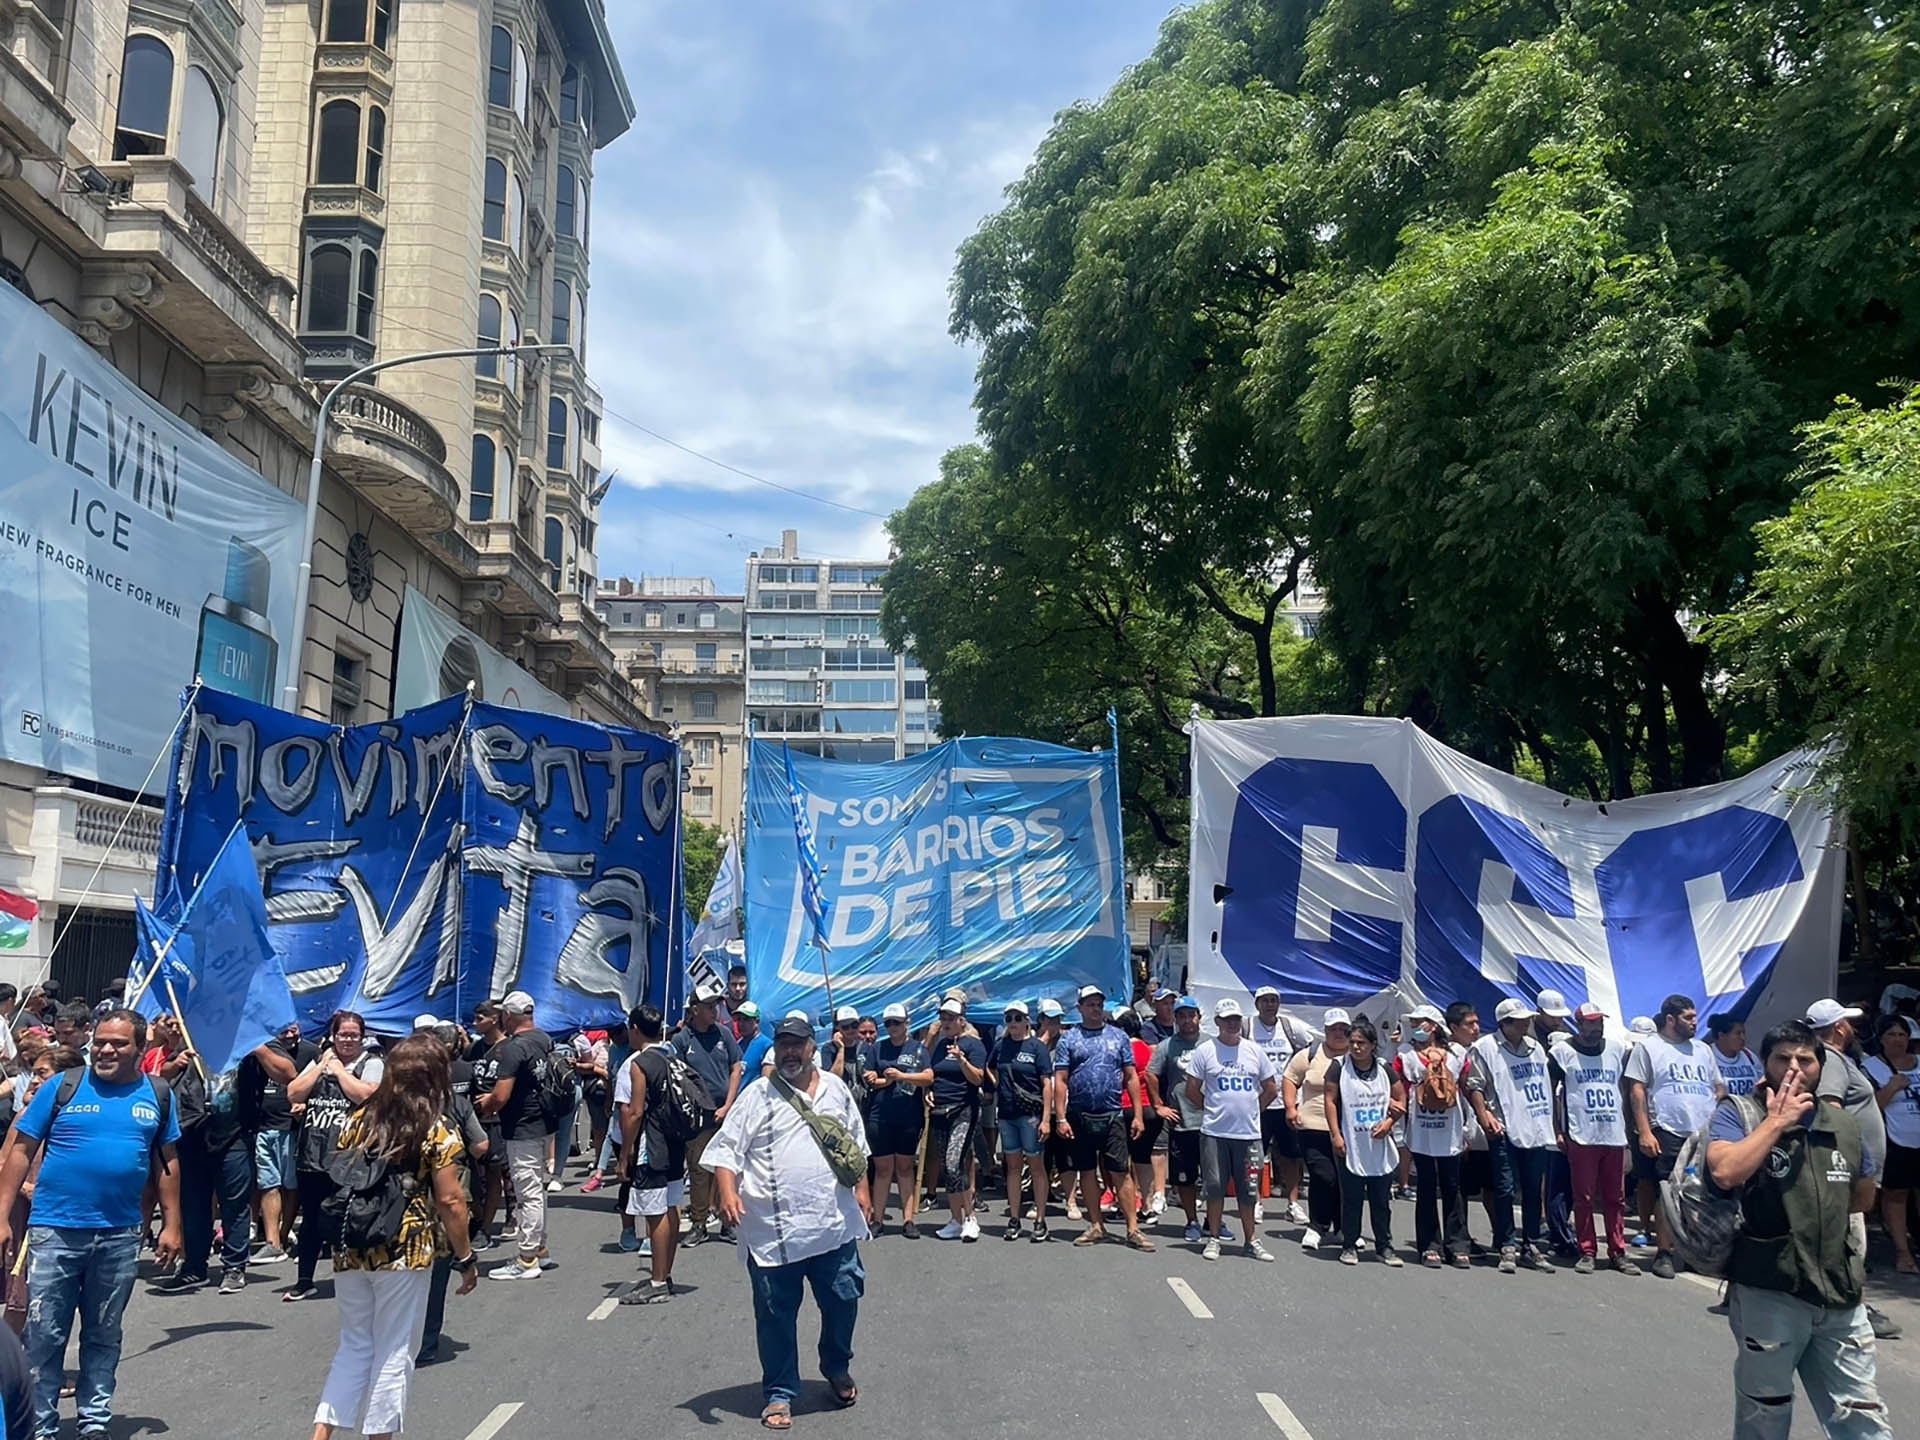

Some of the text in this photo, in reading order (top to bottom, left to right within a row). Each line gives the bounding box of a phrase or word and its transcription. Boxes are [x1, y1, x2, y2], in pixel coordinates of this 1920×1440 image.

[28, 352, 179, 522] KEVIN
[70, 488, 132, 552] ICE
[36, 540, 122, 592] FRAGRANCE
[127, 583, 153, 605] FOR
[155, 599, 181, 620] MEN
[841, 808, 1066, 887] BARRIOS
[829, 856, 1071, 948] DE PIE
[1221, 757, 1804, 1035] CCC
[1217, 1076, 1253, 1092] CCC
[1585, 1088, 1615, 1109] CCC
